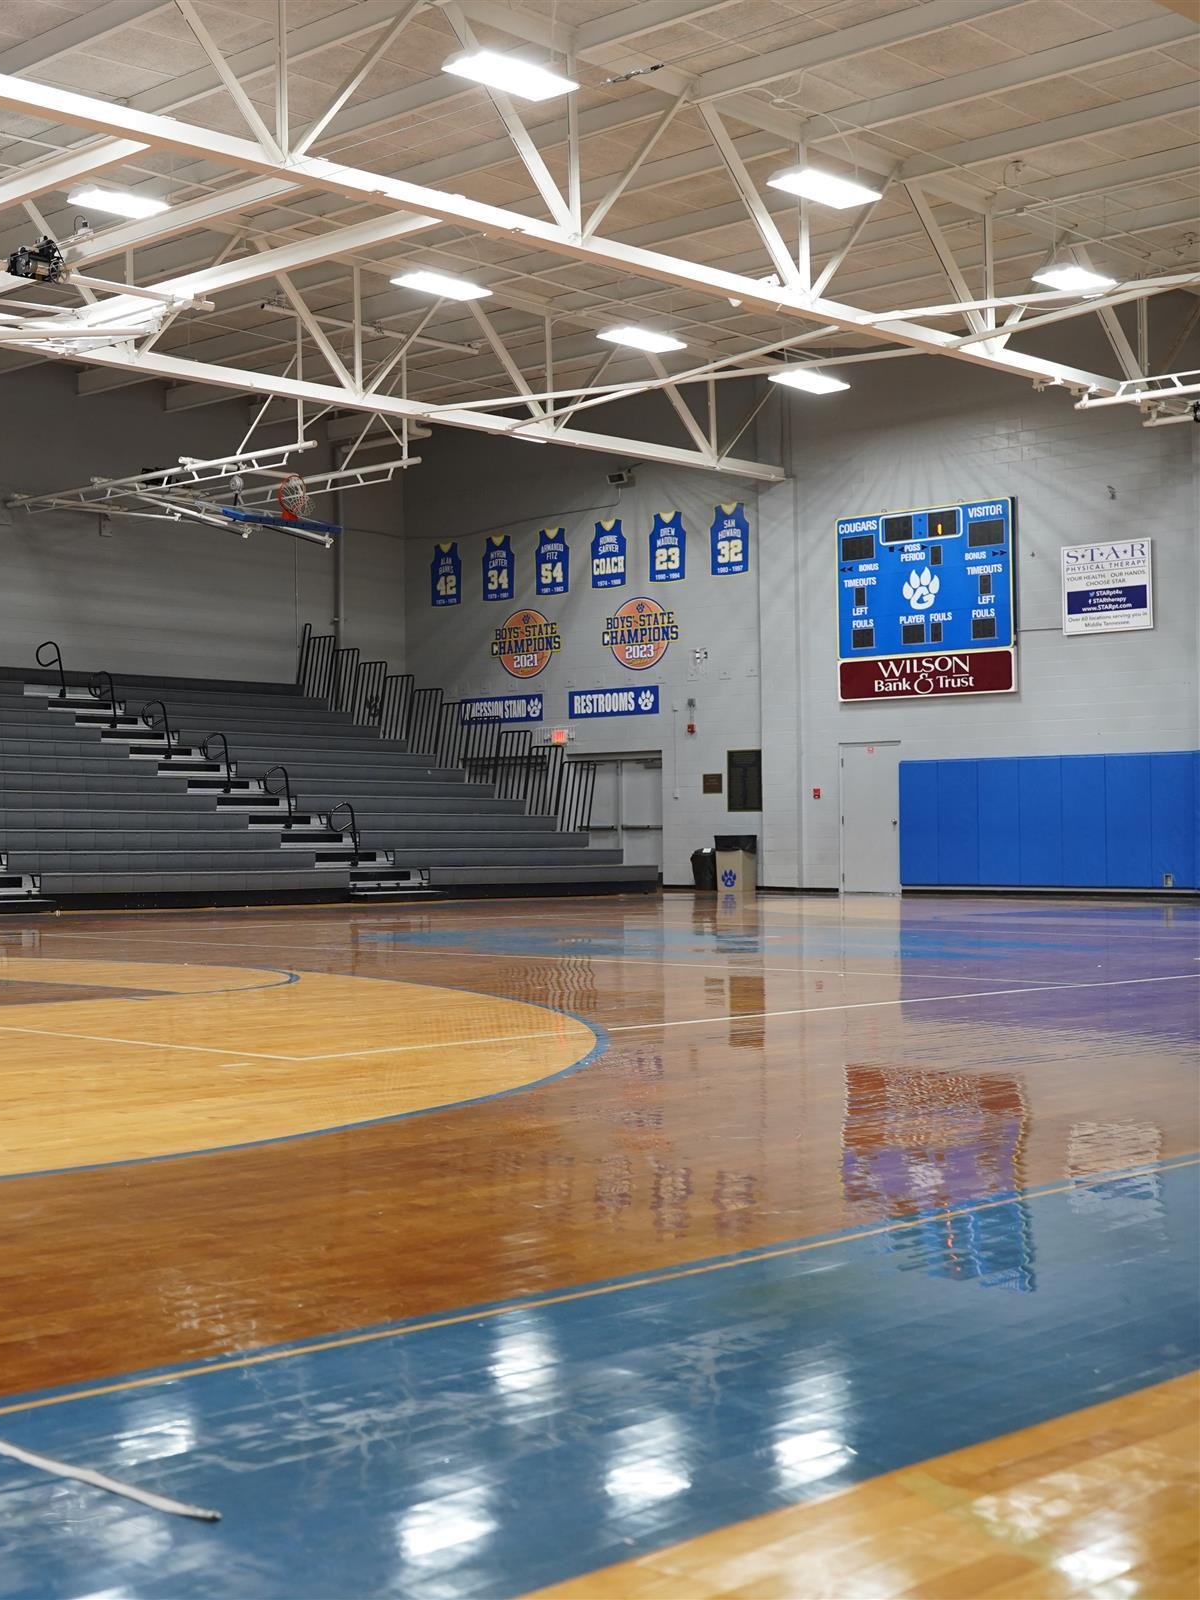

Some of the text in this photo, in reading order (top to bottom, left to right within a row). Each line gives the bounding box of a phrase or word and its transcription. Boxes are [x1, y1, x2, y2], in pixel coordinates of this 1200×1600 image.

[968, 504, 1003, 519] VISITOR
[723, 519, 736, 529] SAM
[839, 520, 878, 535] COUGARS
[660, 527, 676, 537] DREW
[718, 528, 742, 540] HOWARD
[599, 534, 618, 545] RONNIE
[656, 537, 678, 548] MADDUX
[541, 543, 564, 553] ARMANDO
[598, 544, 619, 555] SARVER
[717, 539, 743, 564] 32
[904, 544, 921, 552] POSS
[441, 557, 452, 565] ALAN
[490, 550, 507, 560] MYRON
[546, 551, 558, 560] FITZ
[655, 547, 680, 571] 23
[901, 552, 925, 562] PERIOD
[965, 551, 987, 561] BONUS
[489, 558, 508, 569] CARTER
[593, 556, 625, 576] COACH
[859, 563, 879, 572] BONUS
[1066, 560, 1146, 572] PHYSICAL THERAPY
[439, 565, 454, 575] BANKS
[541, 561, 563, 584] 54
[966, 564, 1003, 576] TIMEOUTS
[437, 575, 457, 596] 42
[487, 568, 509, 591] 34
[843, 577, 877, 588] TIMEOUTS
[978, 595, 996, 605] LEFT
[852, 606, 868, 616] LEFT
[972, 608, 995, 618] FOULS
[1082, 603, 1133, 612] www.STARpt.com
[606, 611, 675, 630] BOYS' STATE
[852, 619, 874, 628] FOULS
[899, 612, 952, 625] PLAYER FOULS
[495, 622, 558, 640] BOYS' STATE
[602, 625, 679, 647] CHAMPIONS
[491, 636, 561, 656] CHAMPIONS
[625, 644, 654, 659] 2023
[513, 653, 539, 669] 2021
[877, 656, 970, 678] WILSON
[874, 672, 974, 694] Bank & Trust
[504, 699, 527, 718] STAND
[574, 691, 635, 714] RESTROOMS
